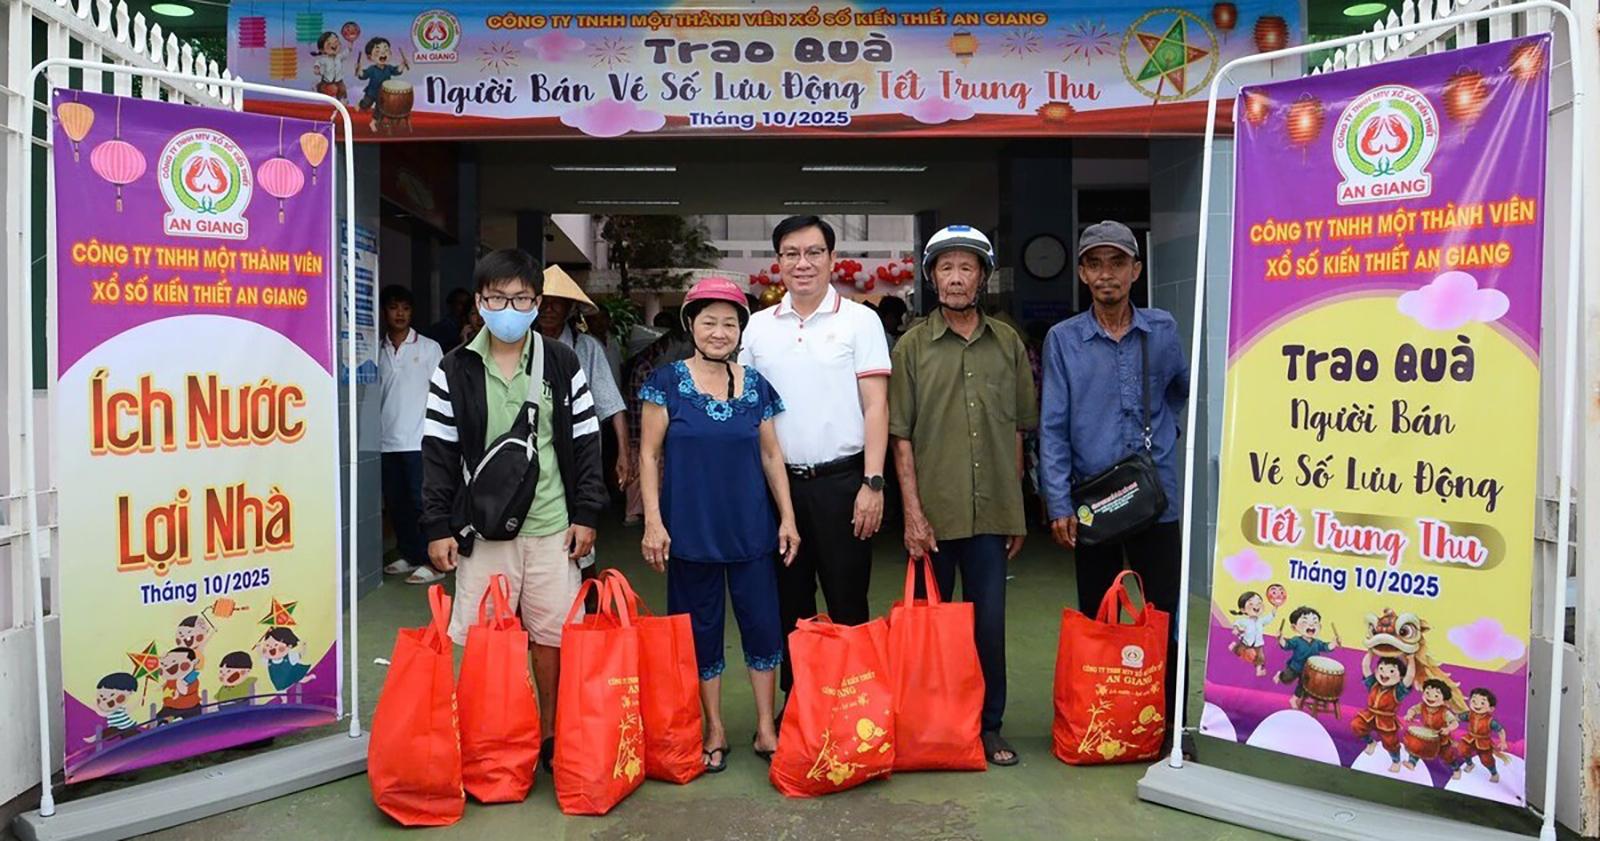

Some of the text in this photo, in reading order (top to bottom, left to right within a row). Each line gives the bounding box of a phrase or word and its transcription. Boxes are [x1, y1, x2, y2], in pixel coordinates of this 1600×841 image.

[487, 6, 1048, 30] CÔNG TY TNHH MỘT THÀNH VIÊN XỔ SỐ KIẾN THIẾT AN GIANG
[644, 32, 893, 64] Trao Quà
[426, 69, 1101, 113] Người Bán Vé Số Lưu Động Tết Trung Thu
[689, 111, 849, 128] Tháng 10/2025
[1342, 179, 1425, 200] AN GIANG
[169, 218, 244, 234] AN GIANG
[1250, 196, 1535, 242] CÔNG TY TNHH MỘT THÀNH VIÊN
[72, 238, 323, 274] CÔNG TY TNHH MỘT THÀNH VIÊN
[1266, 243, 1511, 277] XỔ SỐ KIẾN THIẾT AN GIANG
[92, 271, 308, 307] XỔ SỐ KIẾN THIẾT AN GIANG
[1282, 334, 1475, 383] Trao Quà
[91, 369, 306, 454] Ích Nước
[1291, 398, 1456, 442] Người Bán
[1249, 451, 1505, 513] Vé Số Lưu Động
[117, 483, 294, 575] Lợi Nhà
[1257, 506, 1484, 566] Tết Trung Thu
[141, 568, 270, 604] Tháng 10/2025
[1289, 559, 1439, 598] Tháng 10/2025
